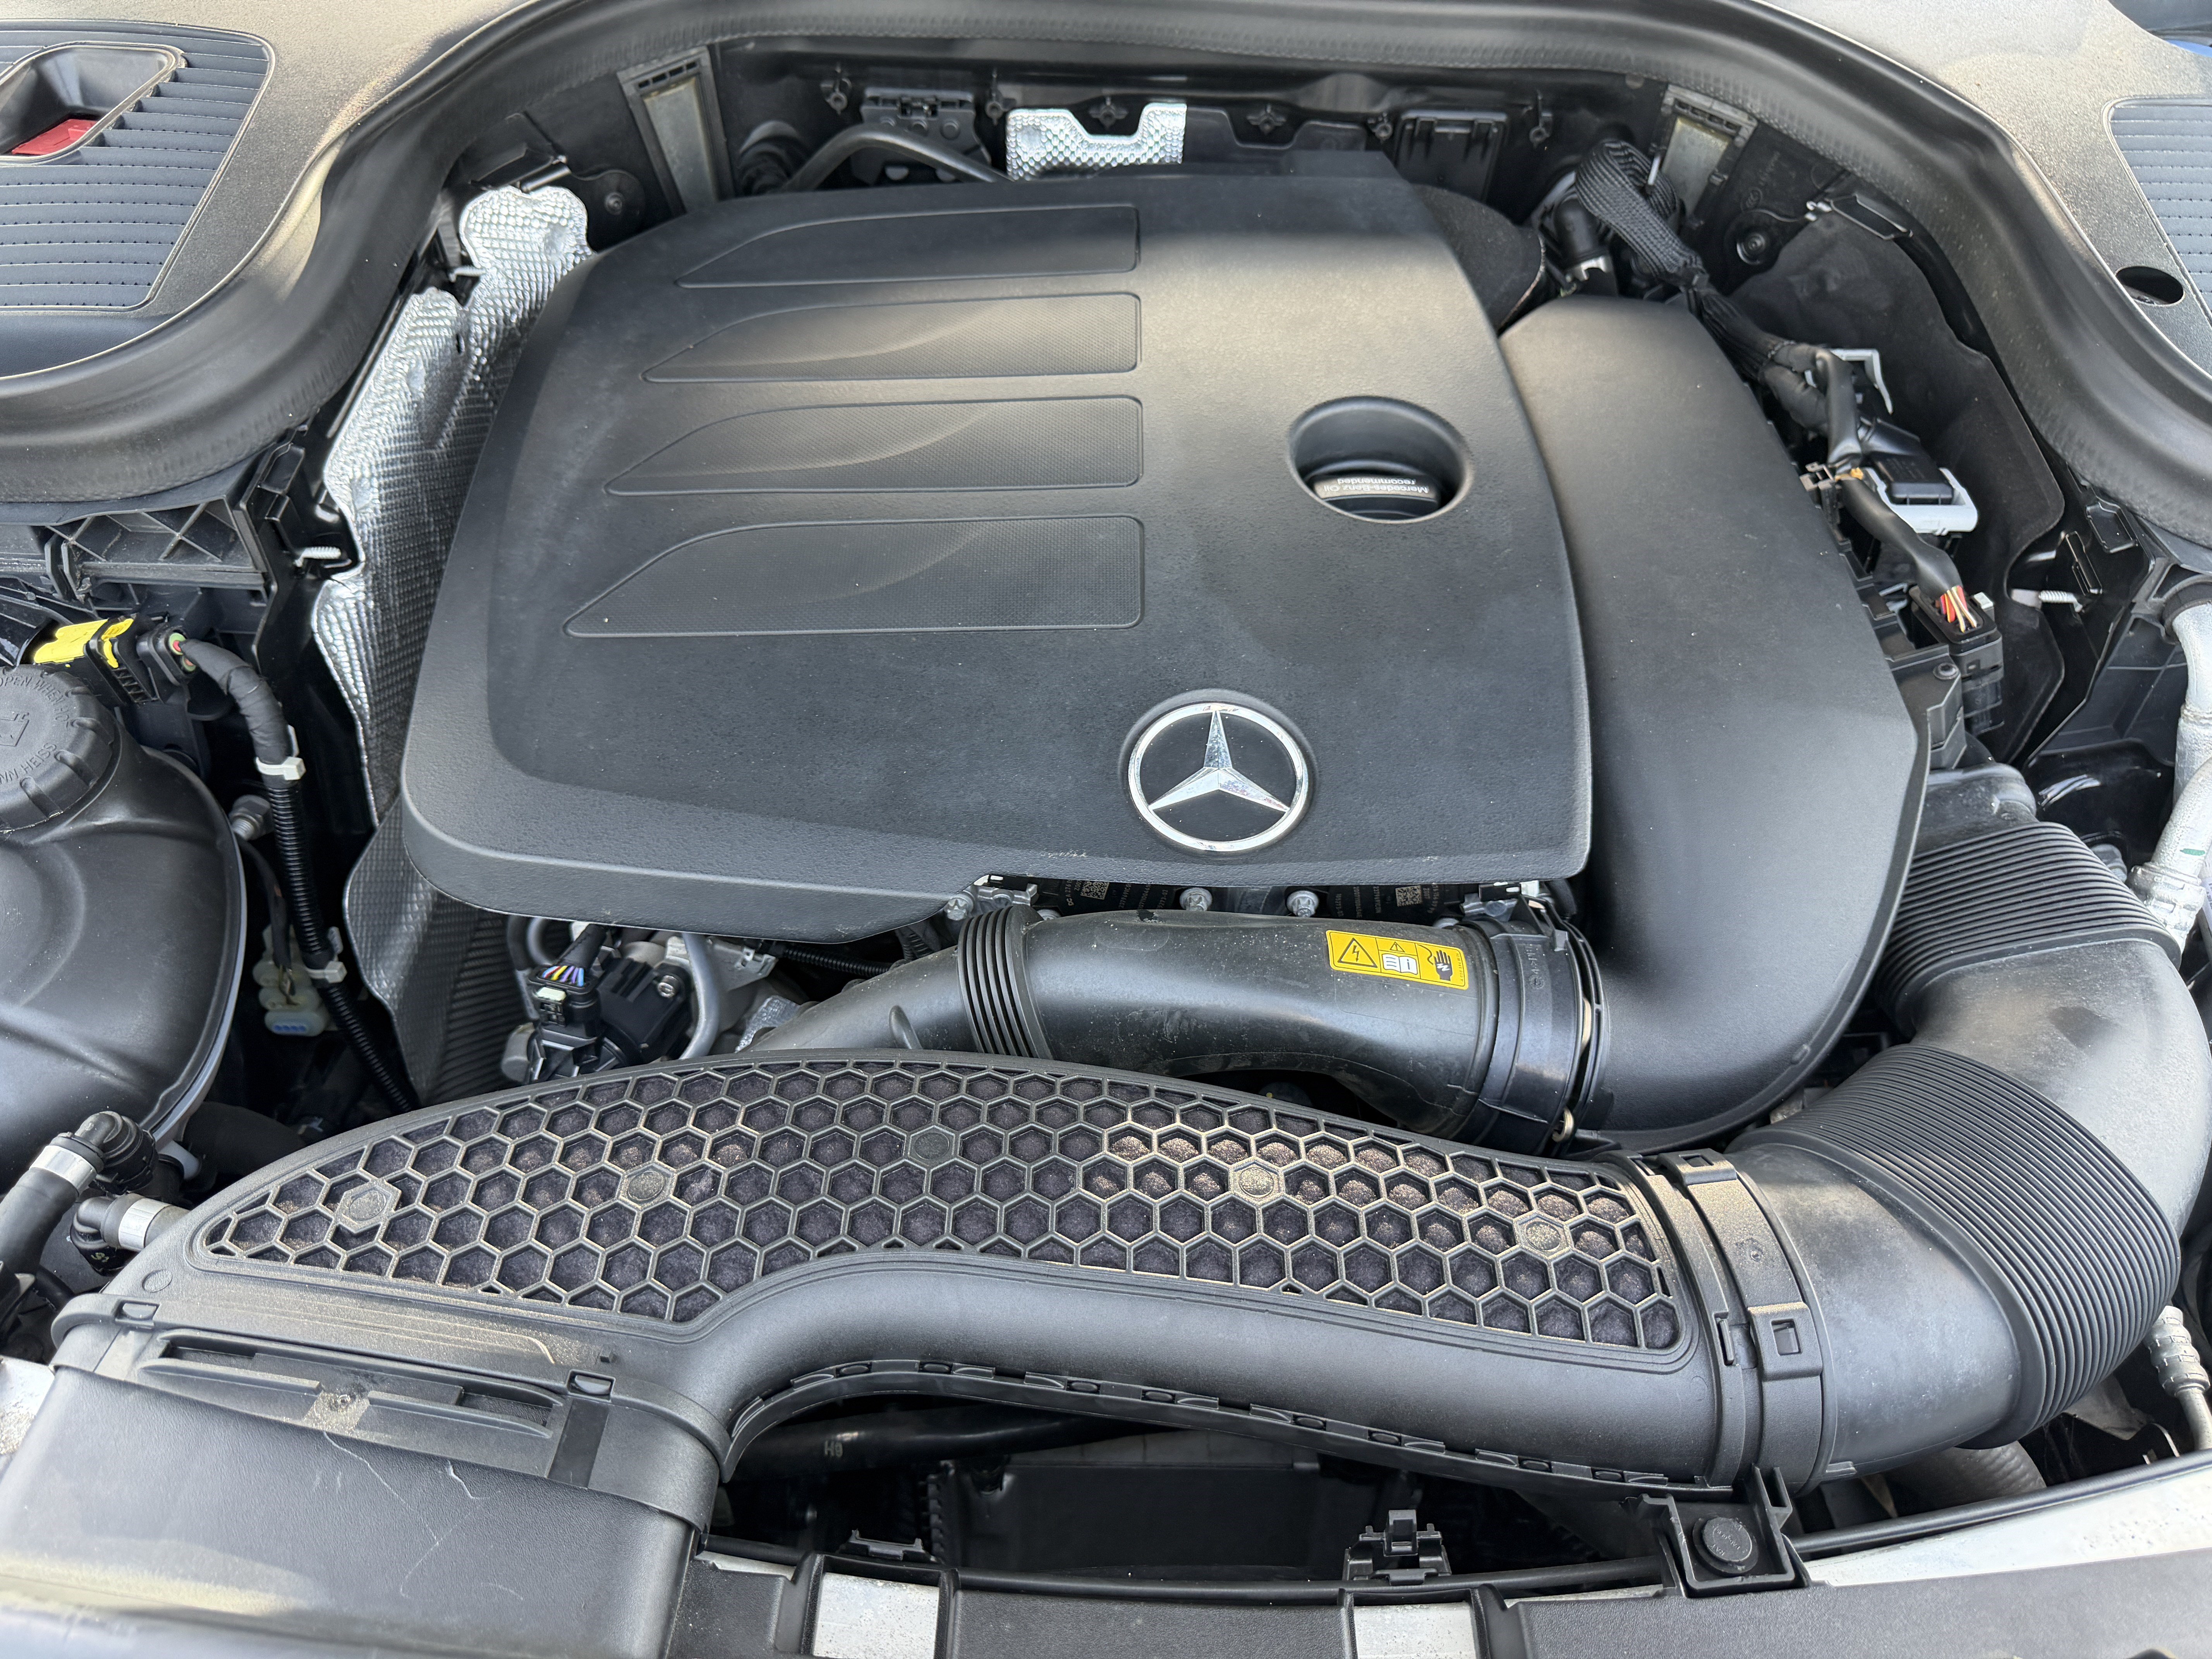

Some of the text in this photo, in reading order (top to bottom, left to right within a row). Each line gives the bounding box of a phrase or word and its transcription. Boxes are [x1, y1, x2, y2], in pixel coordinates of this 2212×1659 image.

[1343, 484, 1429, 493] Mercedes-Benz
[34, 679, 65, 706] WHEN
[21, 743, 57, 774] HEISS
